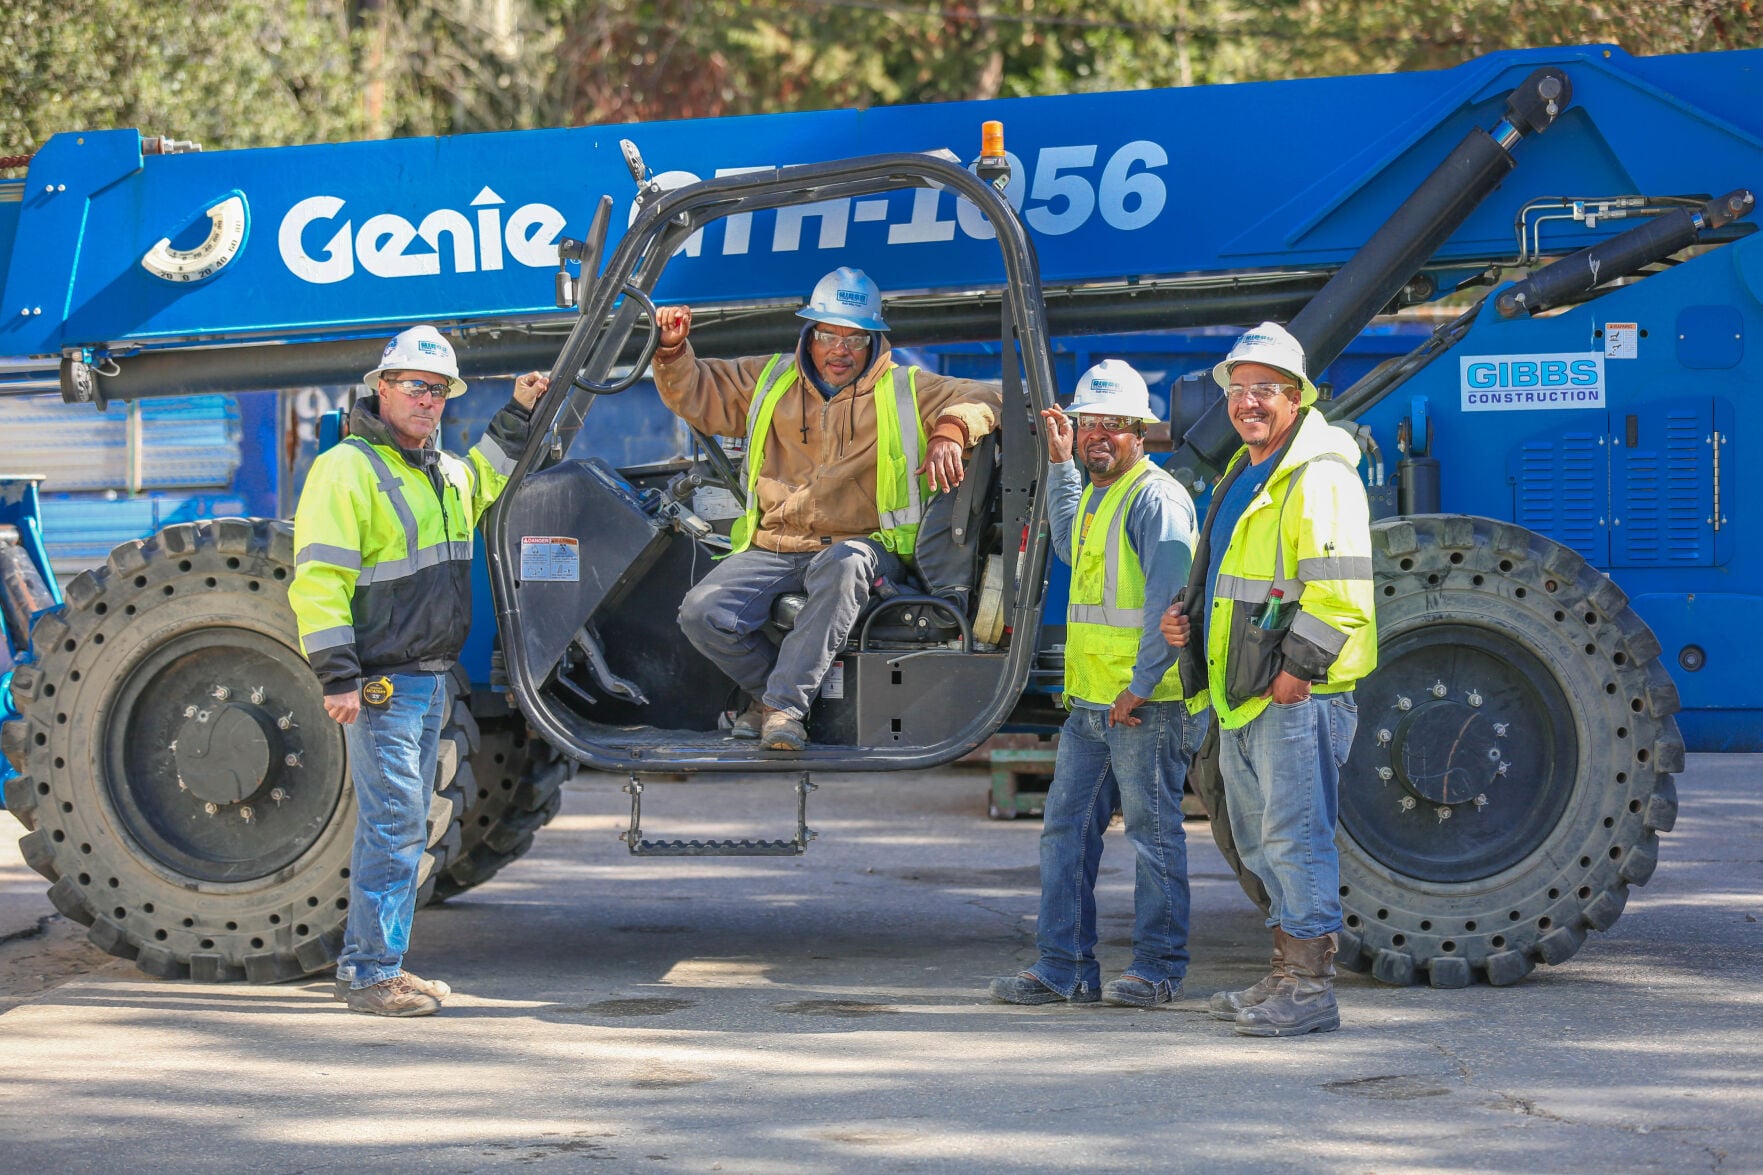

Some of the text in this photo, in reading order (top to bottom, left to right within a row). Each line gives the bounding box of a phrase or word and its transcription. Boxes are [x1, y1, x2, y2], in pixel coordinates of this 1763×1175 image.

[278, 185, 567, 284] Genie
[215, 256, 228, 267] 40
[1467, 359, 1598, 388] GIBBS
[1468, 391, 1599, 404] CONSTRUCTION
